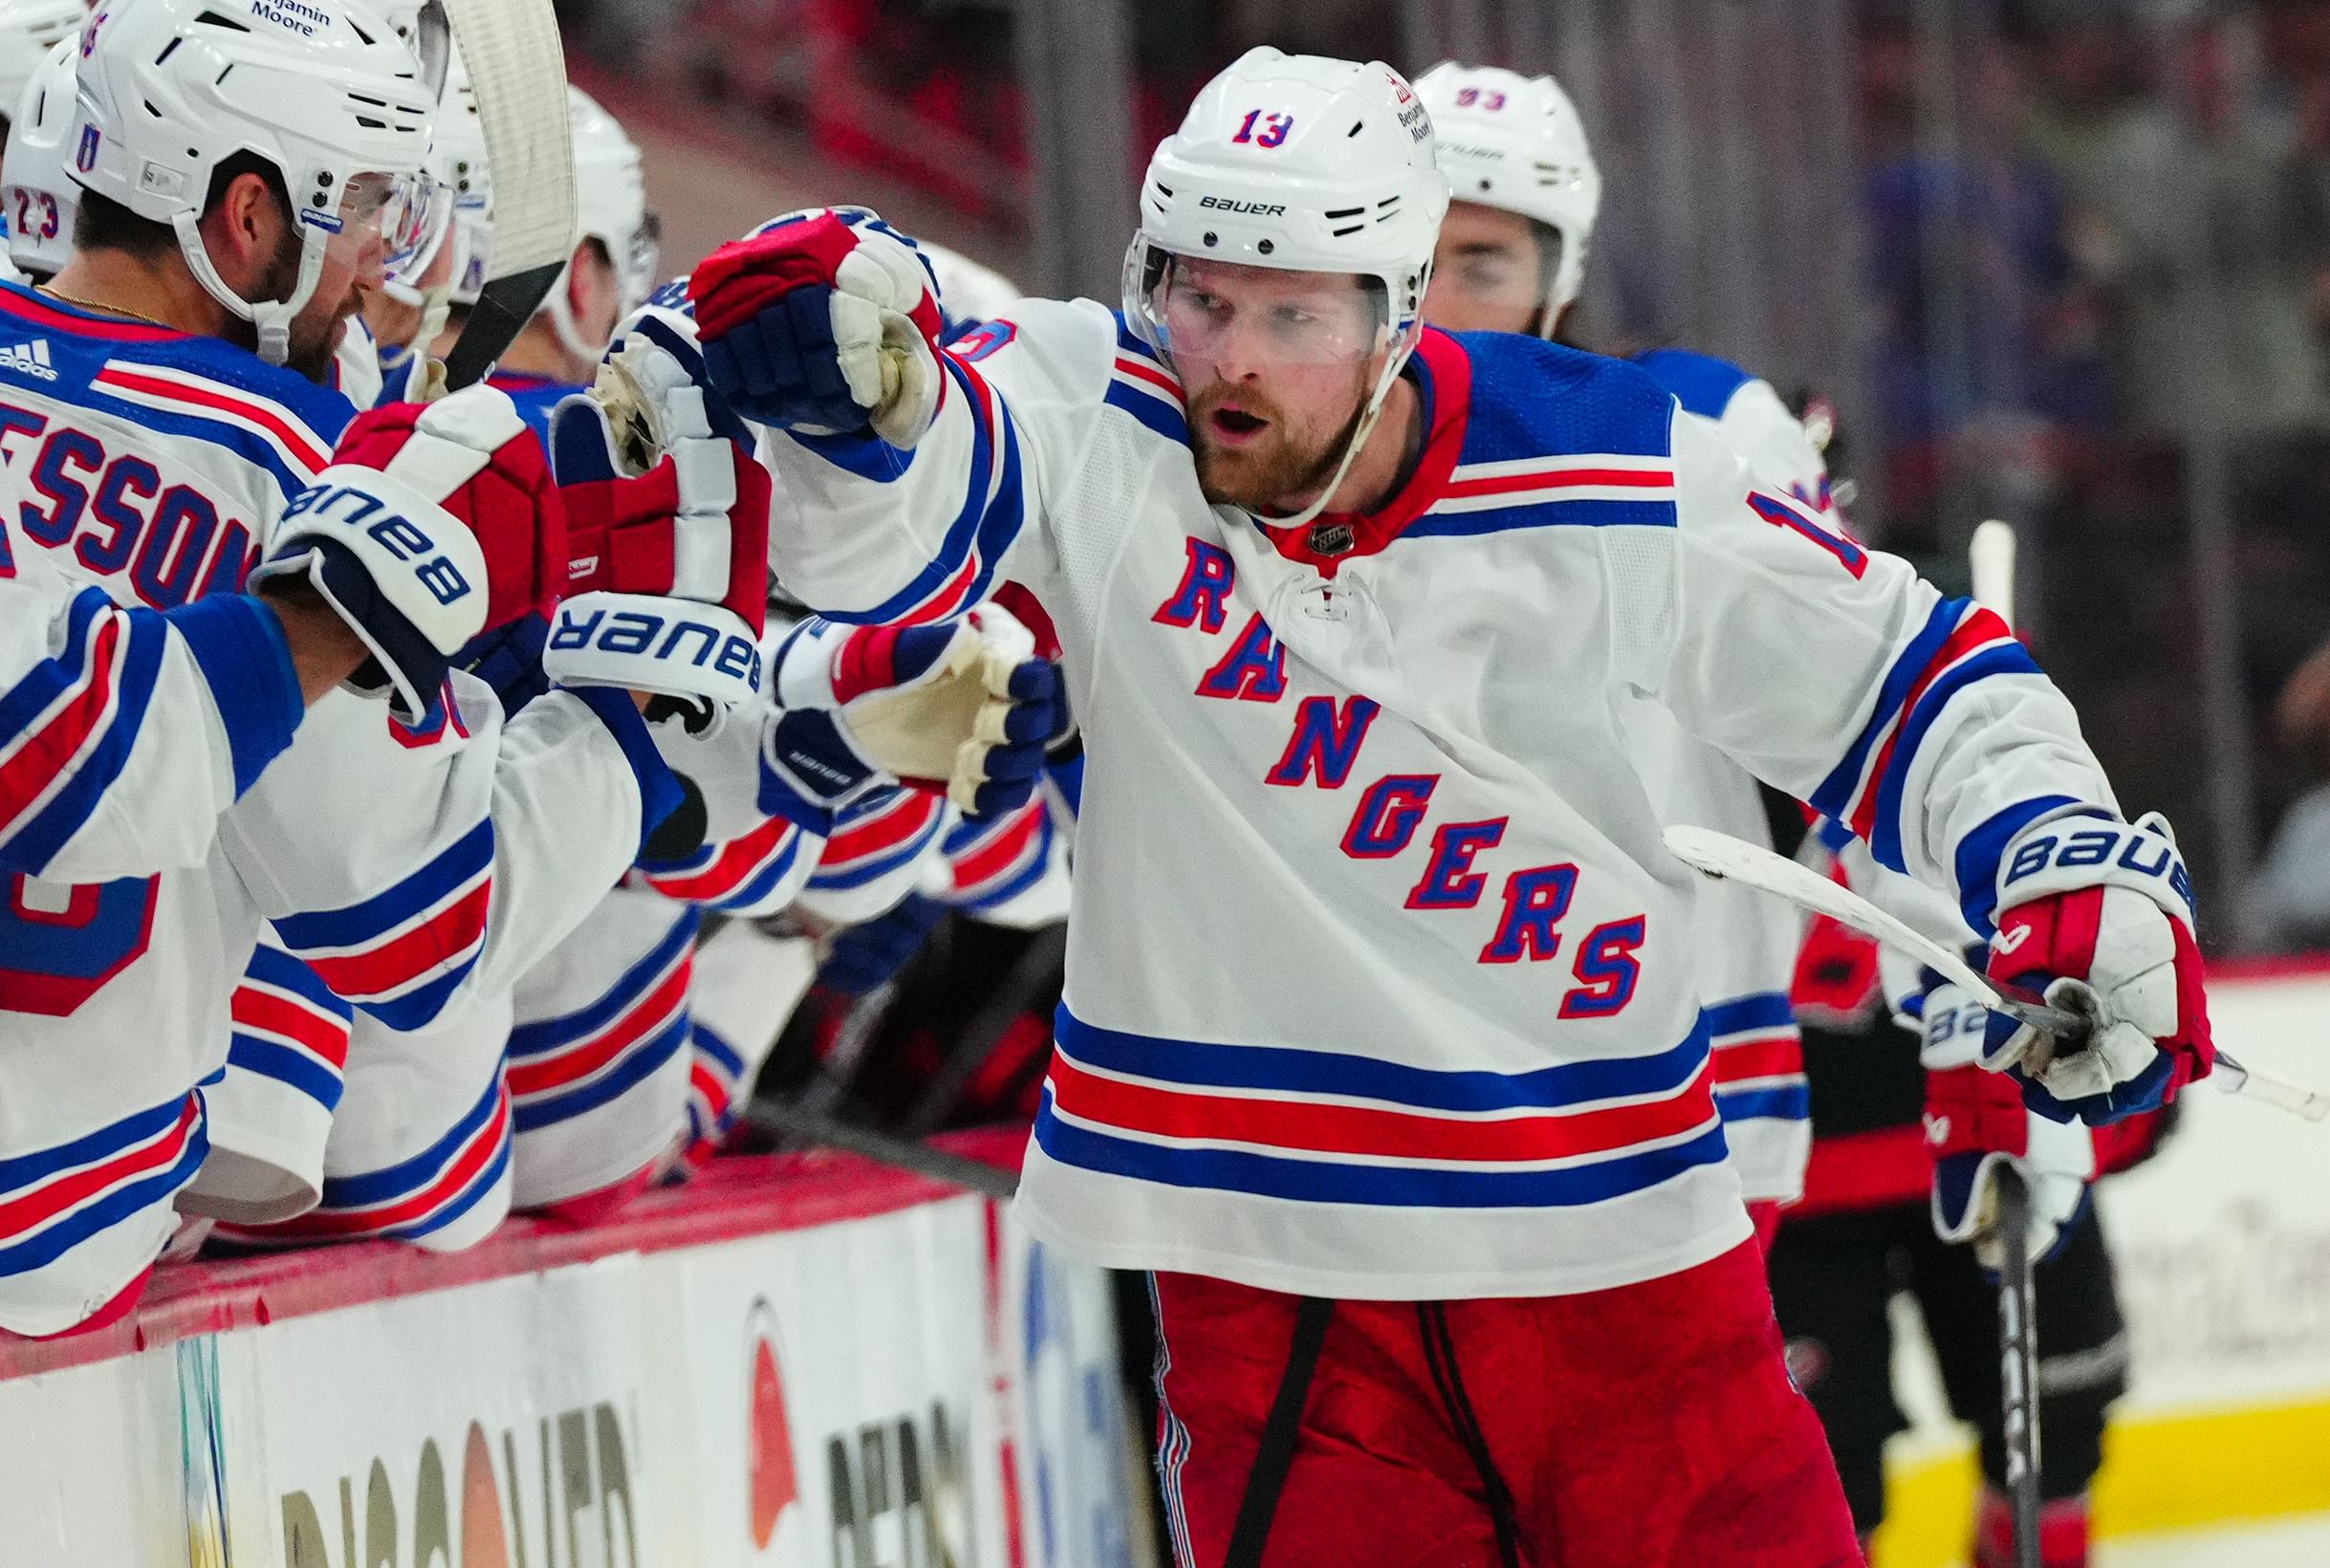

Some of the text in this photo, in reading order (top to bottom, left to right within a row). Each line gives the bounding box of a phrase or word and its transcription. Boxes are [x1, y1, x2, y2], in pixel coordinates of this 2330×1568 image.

[251, 1, 314, 36] Moore
[1232, 109, 1294, 148] 13
[13, 186, 58, 239] 23
[1150, 535, 1645, 1020] RANGERS
